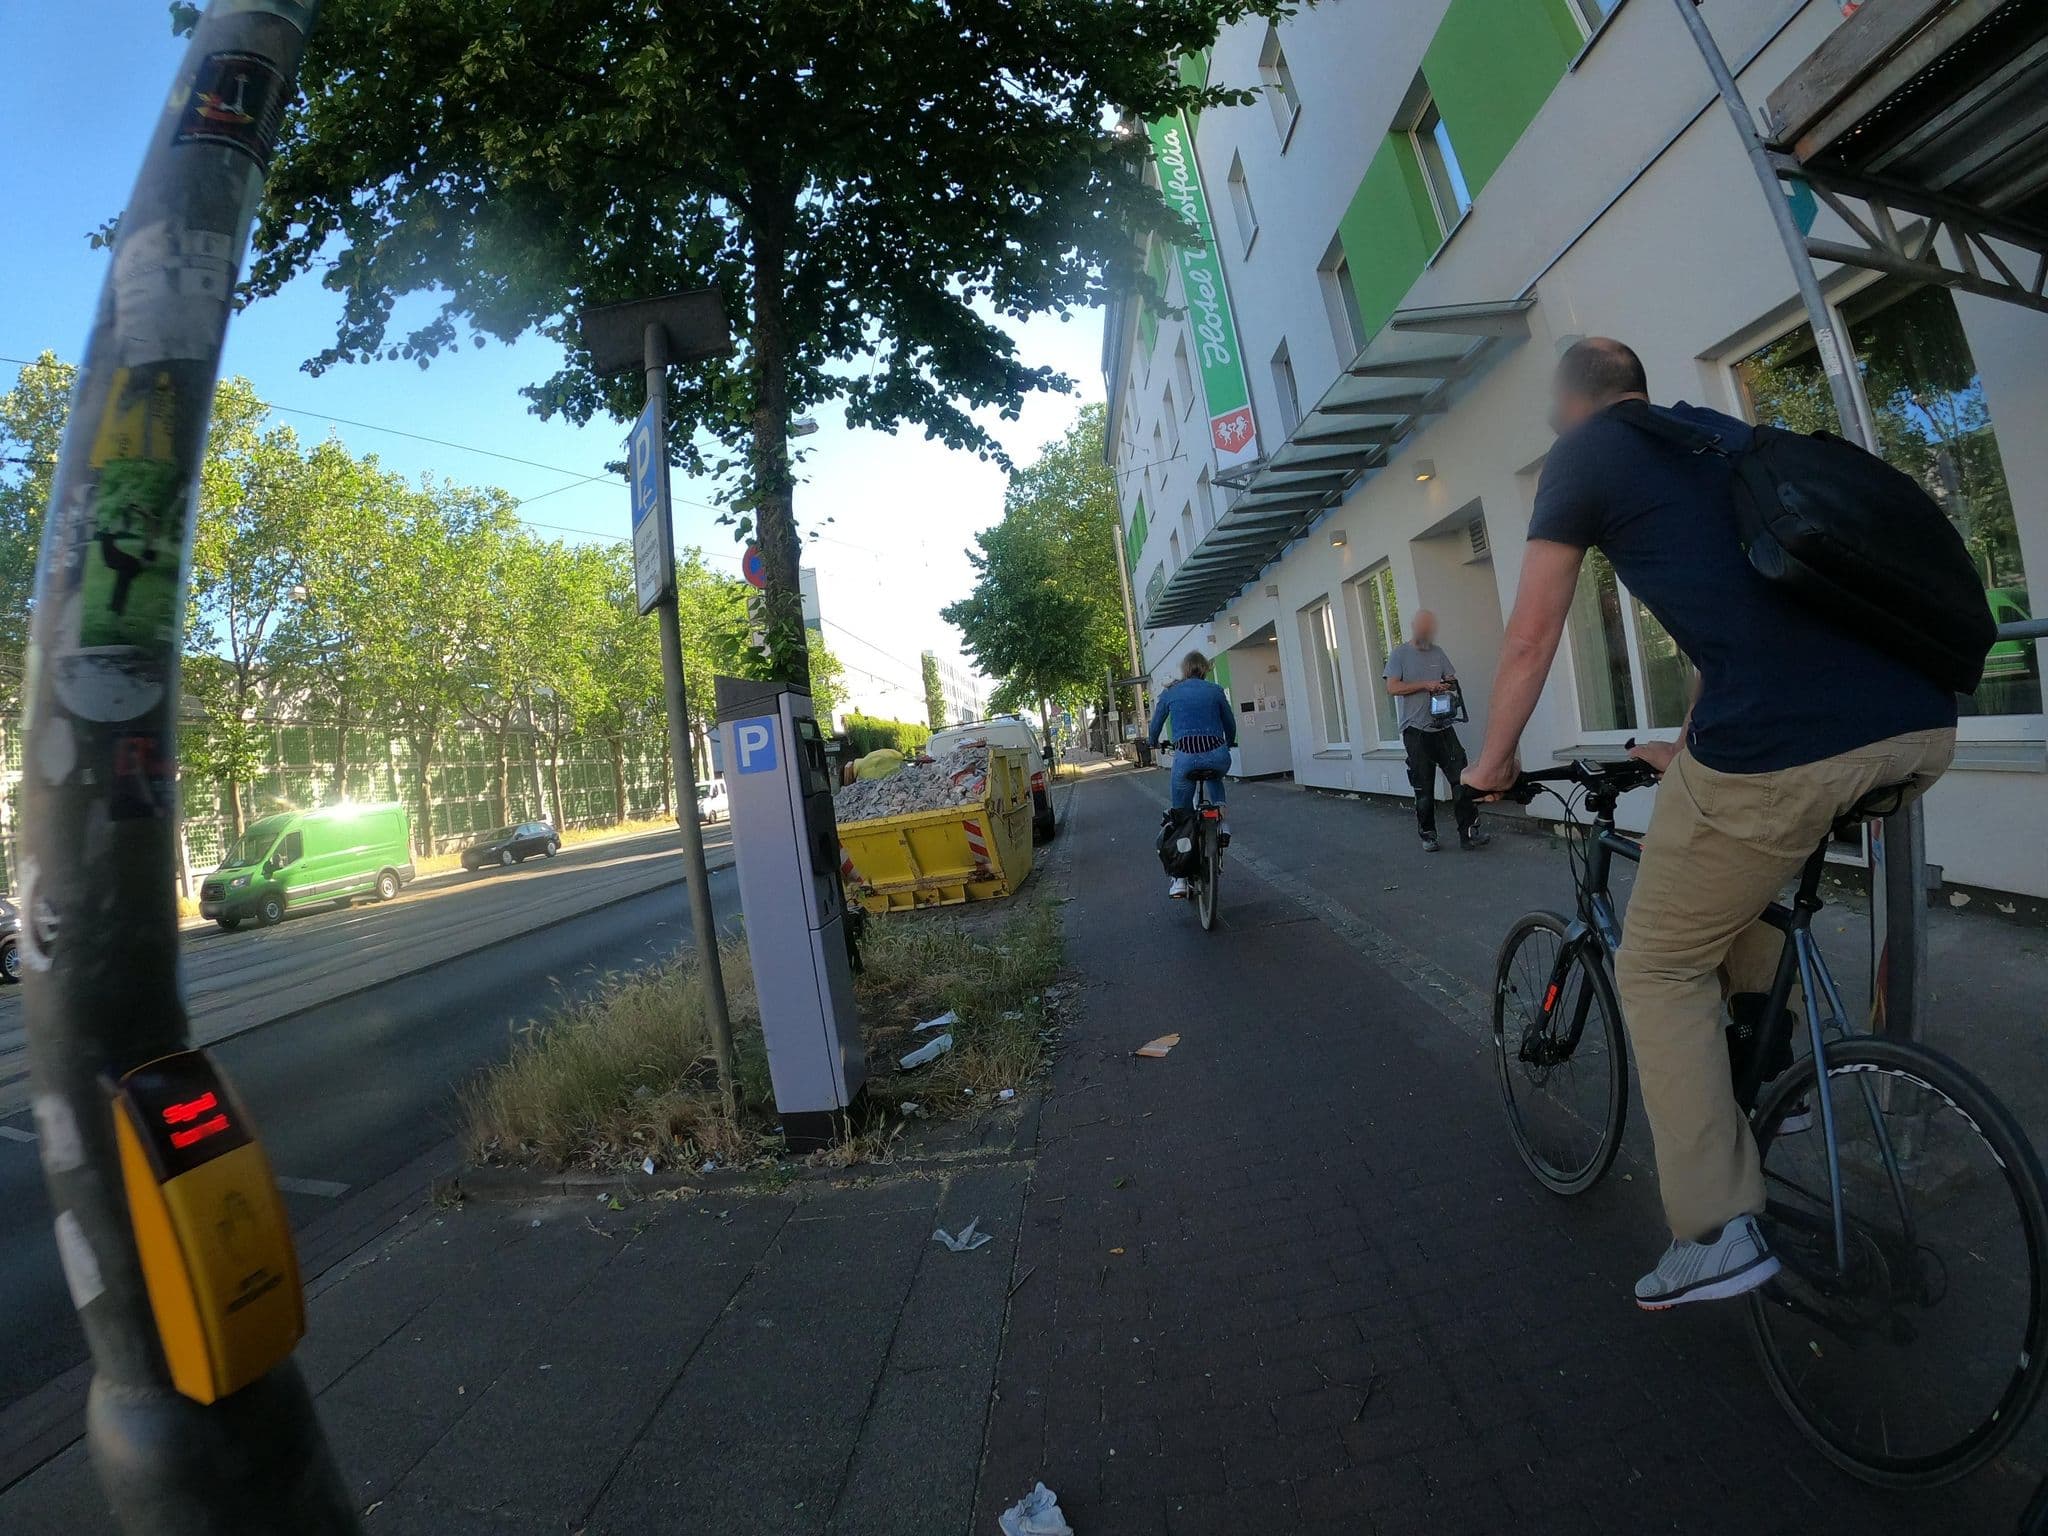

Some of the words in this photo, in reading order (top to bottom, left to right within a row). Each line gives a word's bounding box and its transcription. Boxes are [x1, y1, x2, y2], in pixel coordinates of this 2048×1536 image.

[1188, 268, 1231, 369] Hotel
[635, 425, 650, 511] P
[738, 725, 769, 767] P
